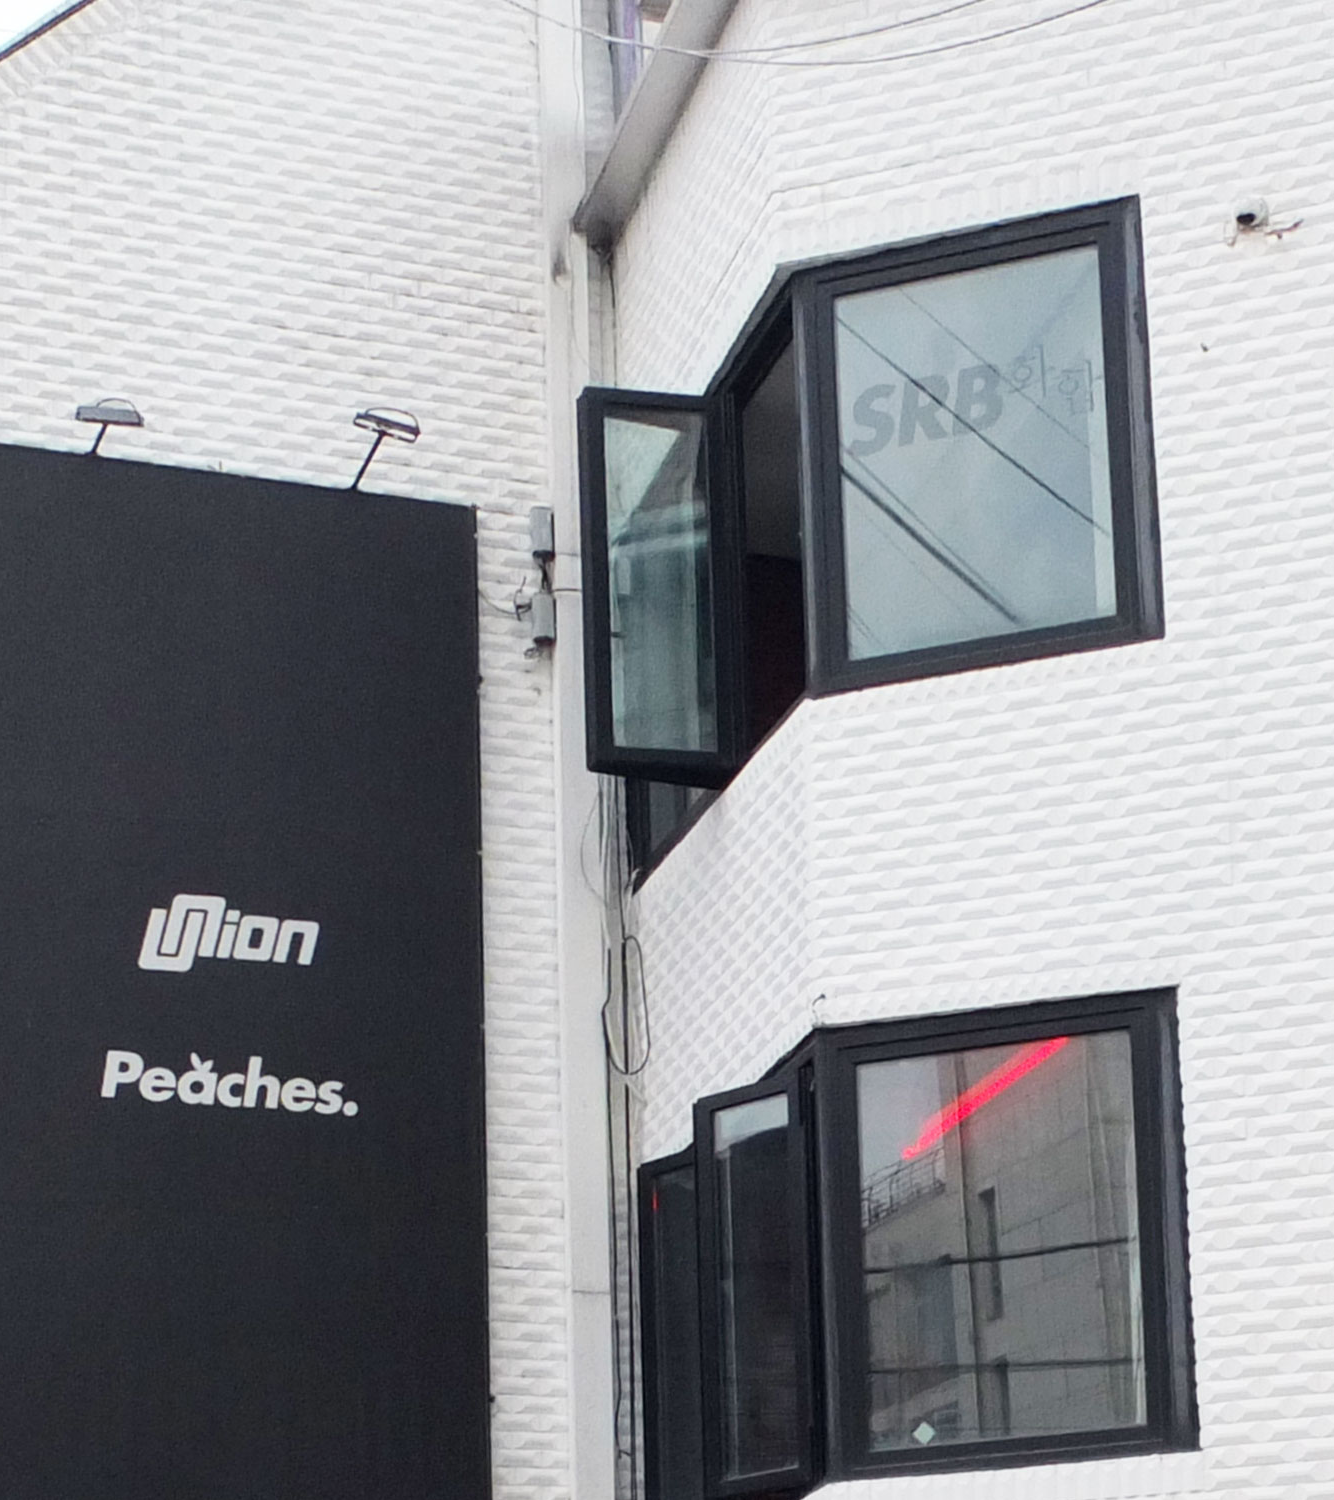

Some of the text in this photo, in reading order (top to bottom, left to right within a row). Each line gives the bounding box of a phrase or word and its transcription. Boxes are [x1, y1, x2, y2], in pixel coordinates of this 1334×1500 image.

[849, 364, 1004, 457] SRB
[138, 893, 319, 972] Union
[101, 1050, 358, 1116] Peaches.
